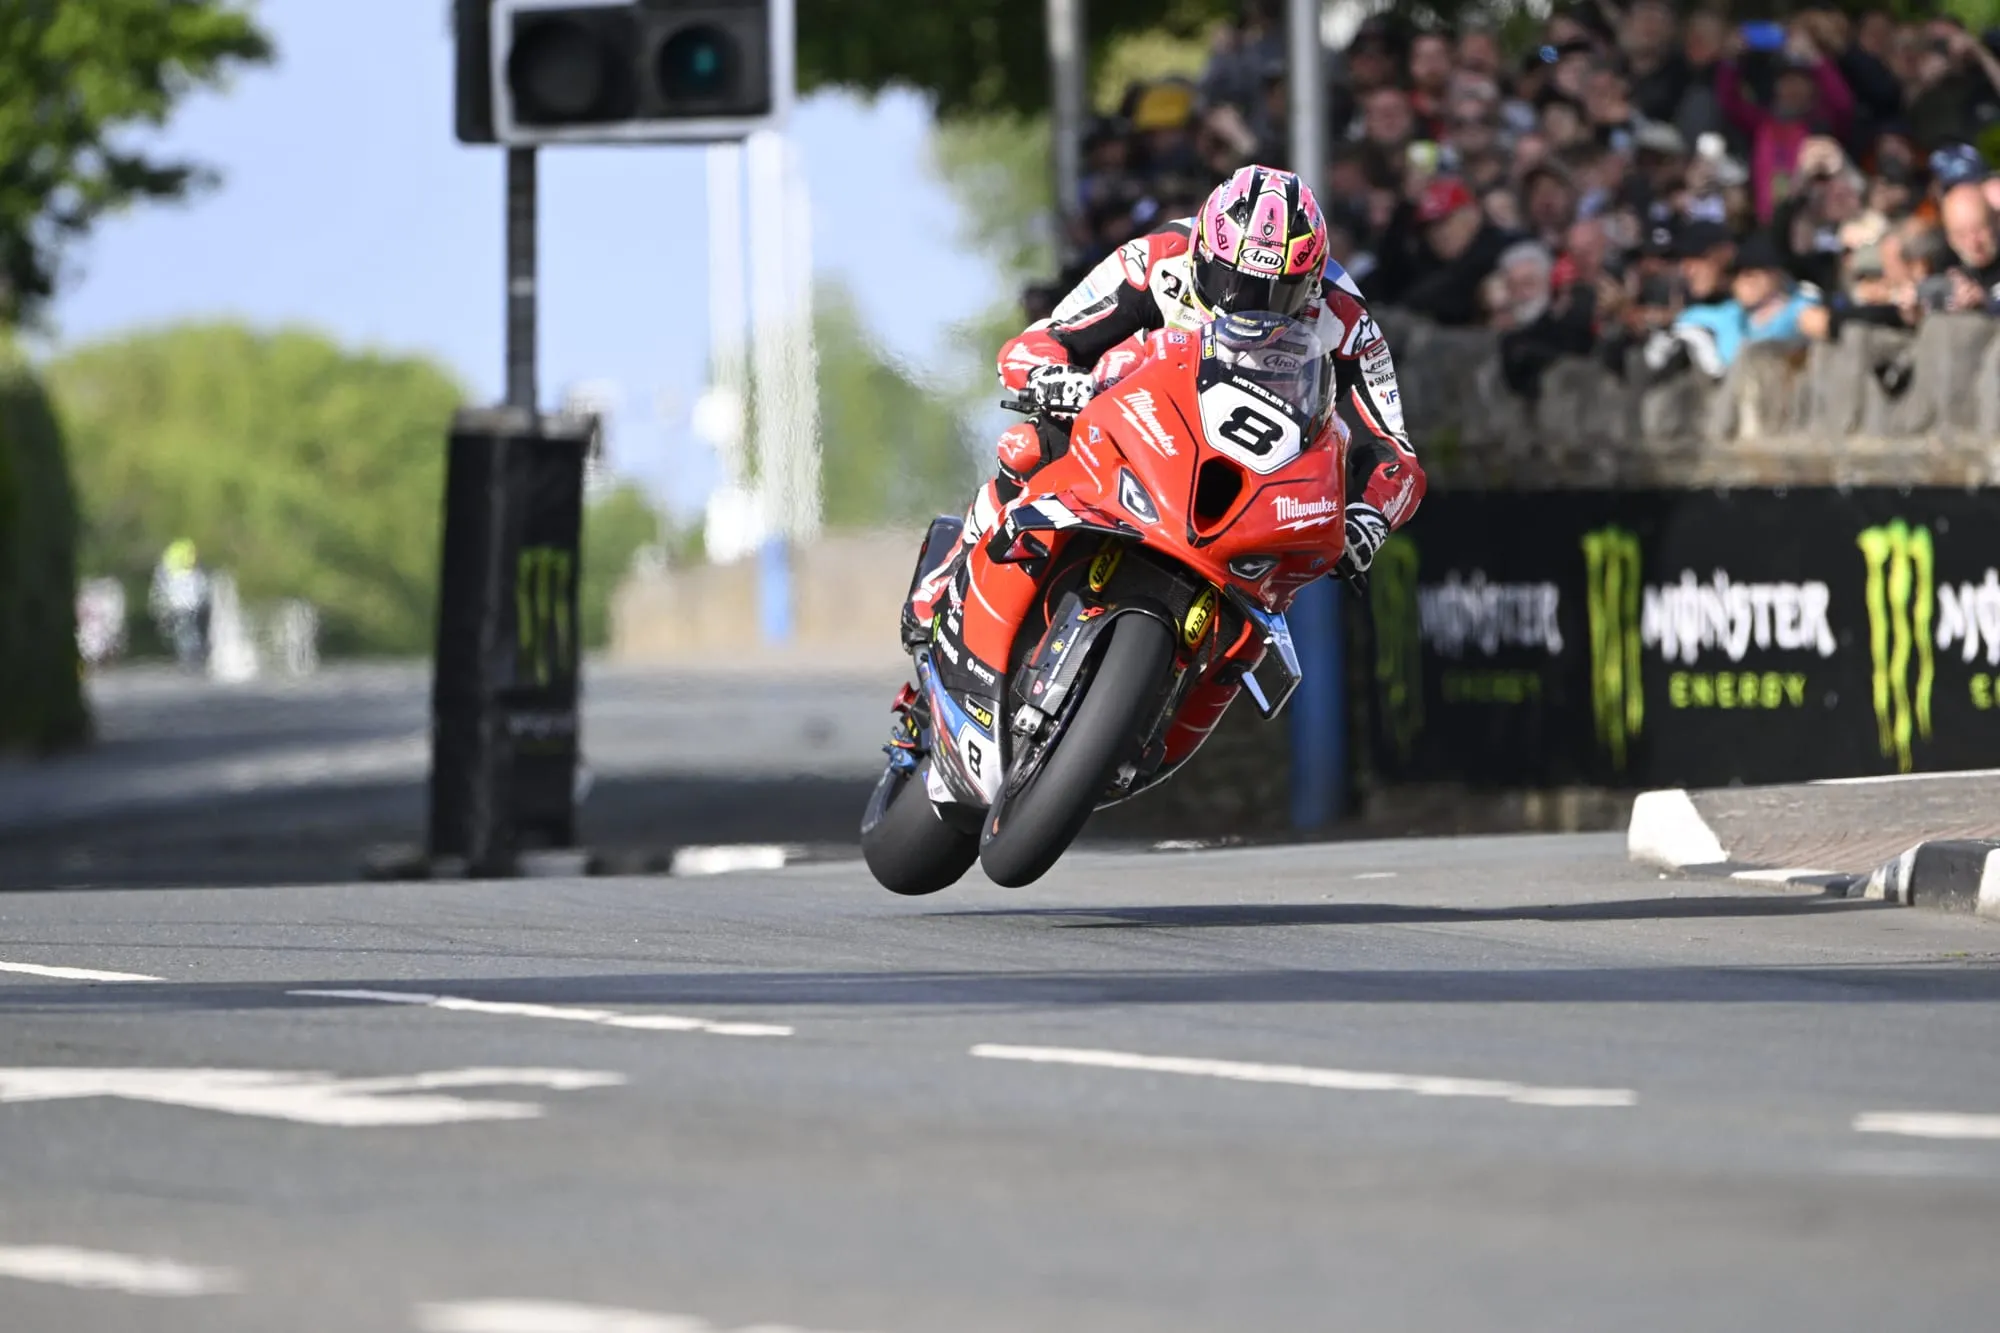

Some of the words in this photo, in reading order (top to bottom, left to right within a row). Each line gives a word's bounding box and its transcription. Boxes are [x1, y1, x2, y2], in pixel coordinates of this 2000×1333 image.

[1246, 249, 1280, 267] Arai
[1123, 387, 1180, 457] Milwaukee
[1218, 405, 1284, 457] 8
[1270, 495, 1339, 522] Milwaukee
[1643, 567, 1836, 664] MONSTER
[1669, 672, 1806, 709] ENERGY
[968, 739, 982, 781] 8
